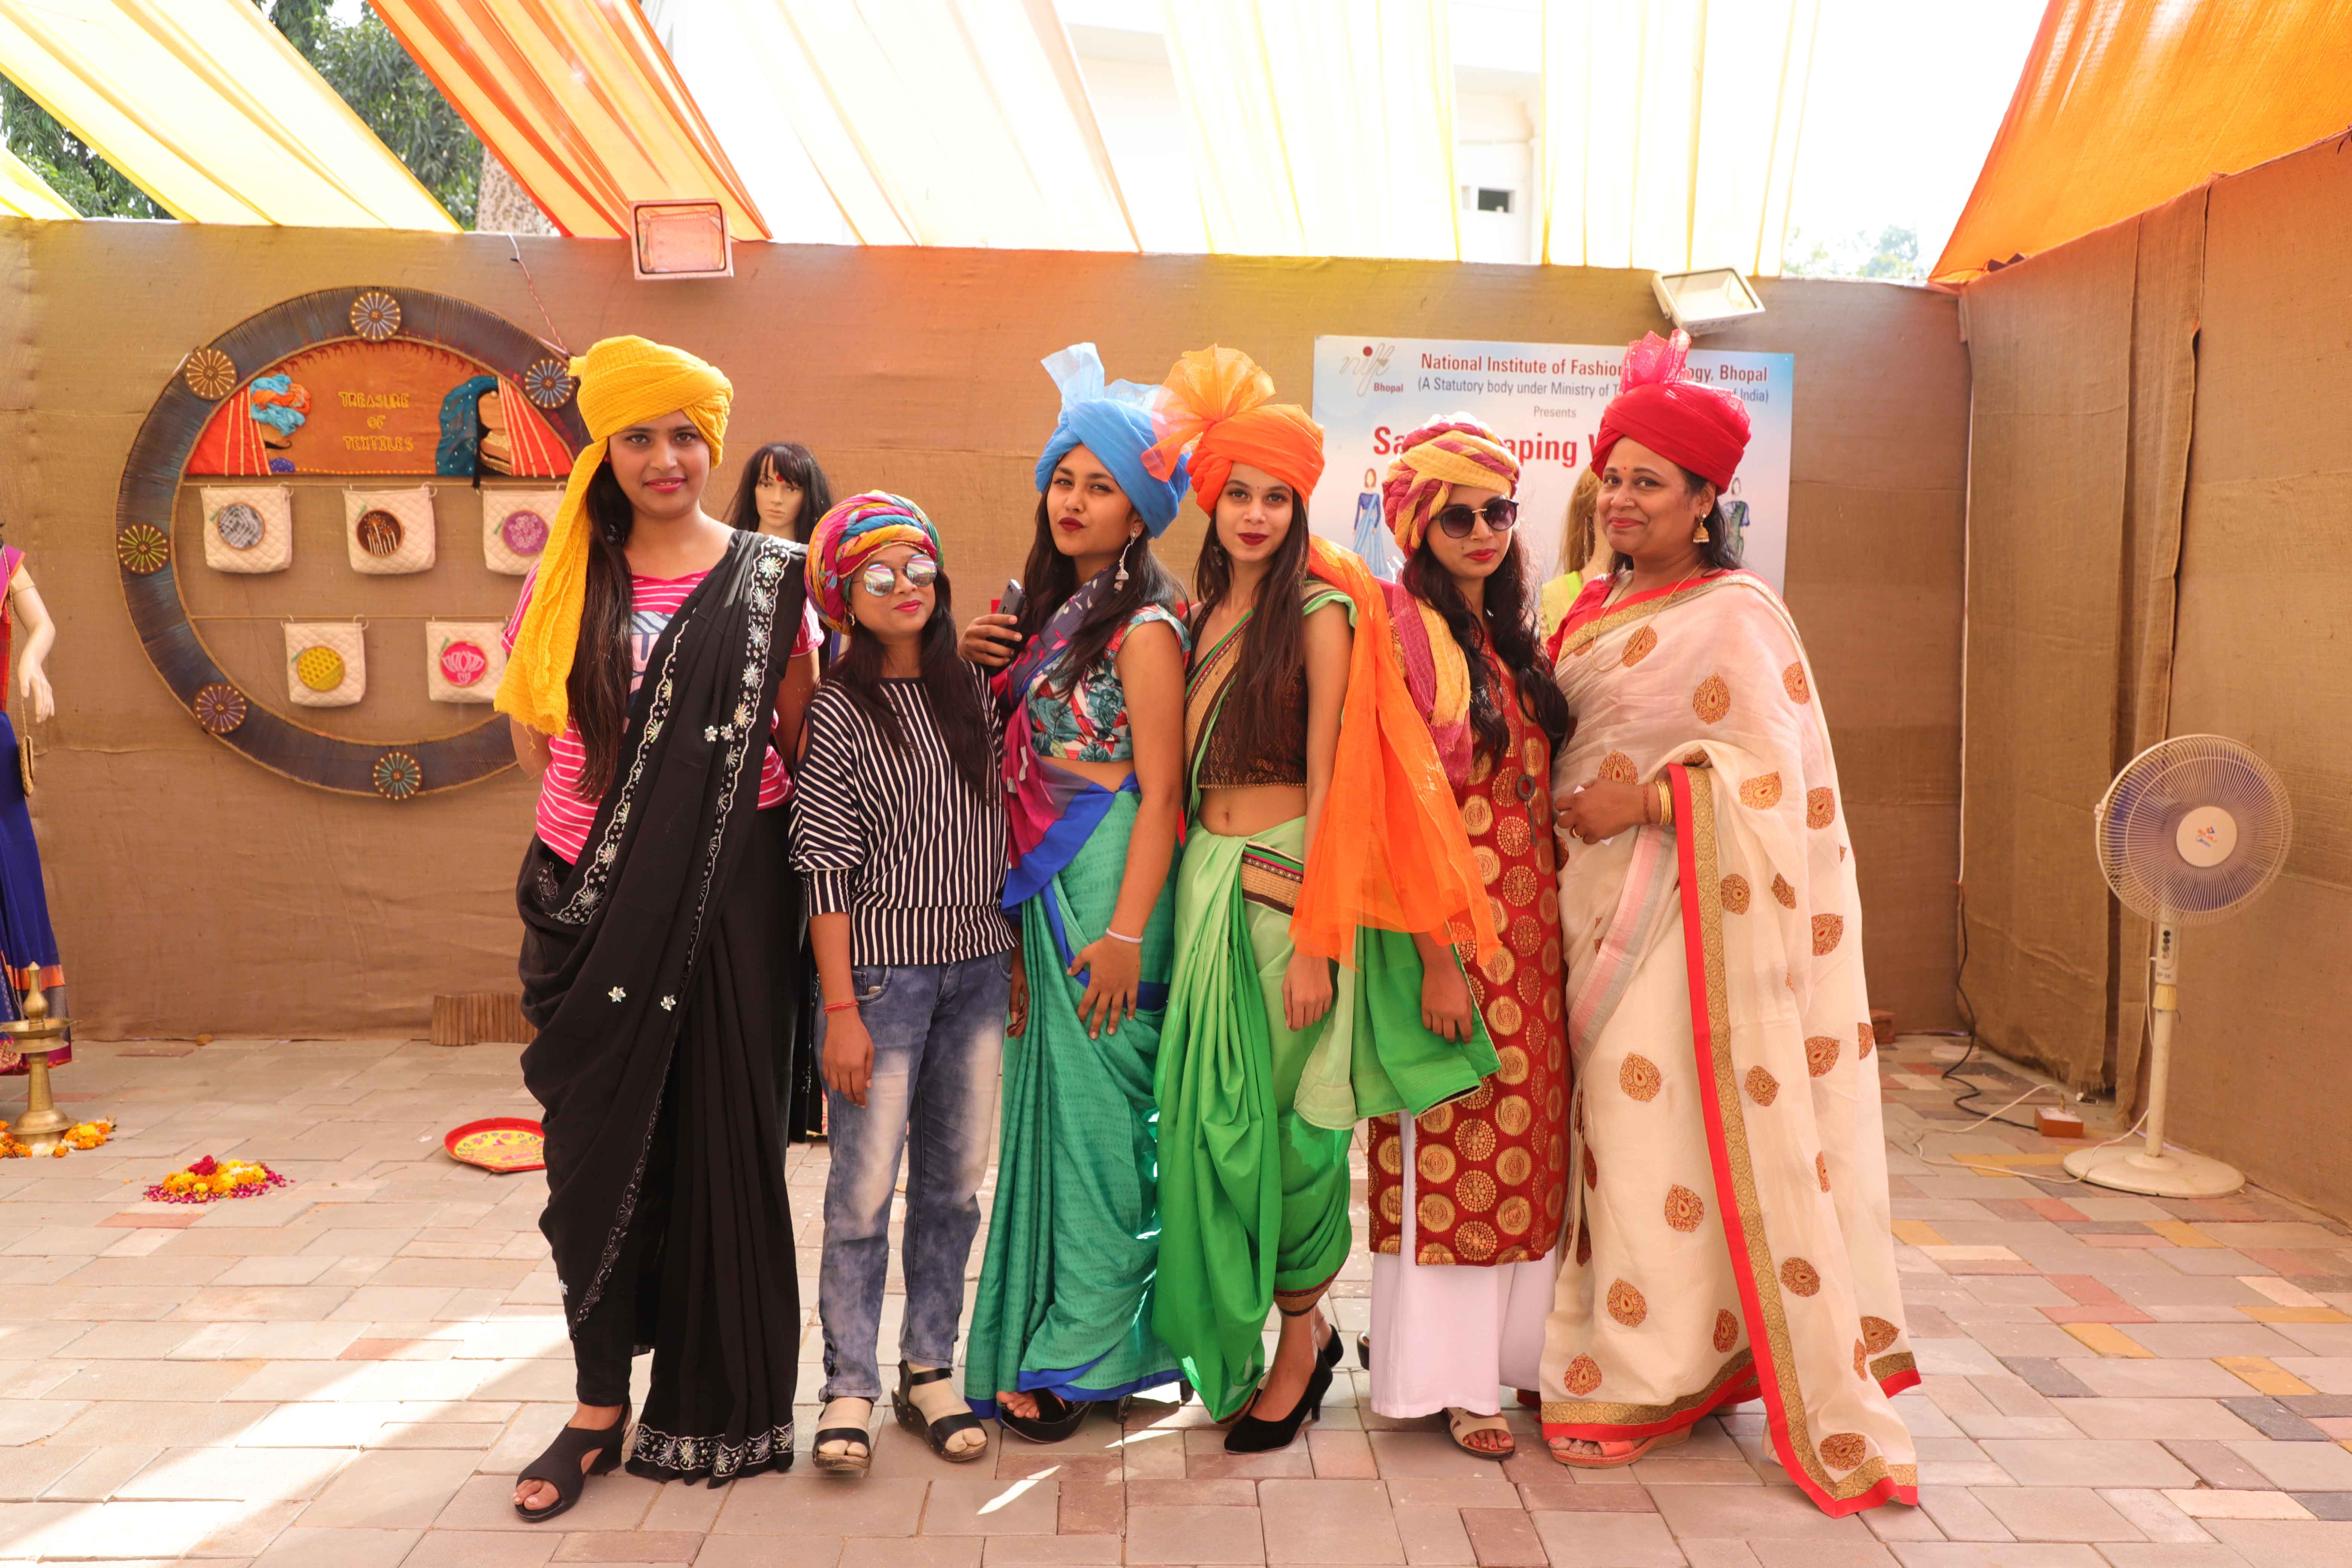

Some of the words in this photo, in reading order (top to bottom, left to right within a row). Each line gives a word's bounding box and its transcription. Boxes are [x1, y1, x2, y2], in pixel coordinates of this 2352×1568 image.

[1421, 353, 1481, 371] National
[1488, 356, 1547, 374] Institute
[1552, 359, 1566, 375] of
[1720, 364, 1768, 384] Bhopal
[1374, 382, 1404, 394] Bhopal
[1418, 377, 1430, 392] (A
[1434, 377, 1484, 395] Statutory
[1487, 380, 1514, 396] body
[1517, 381, 1547, 395] under
[1551, 382, 1596, 399] Ministry
[1599, 384, 1609, 396] of
[1740, 387, 1769, 404] India)
[338, 391, 410, 409] TREASURE
[1534, 406, 1577, 418] Presents
[367, 415, 386, 429] OF
[343, 435, 414, 452] TEXTILES
